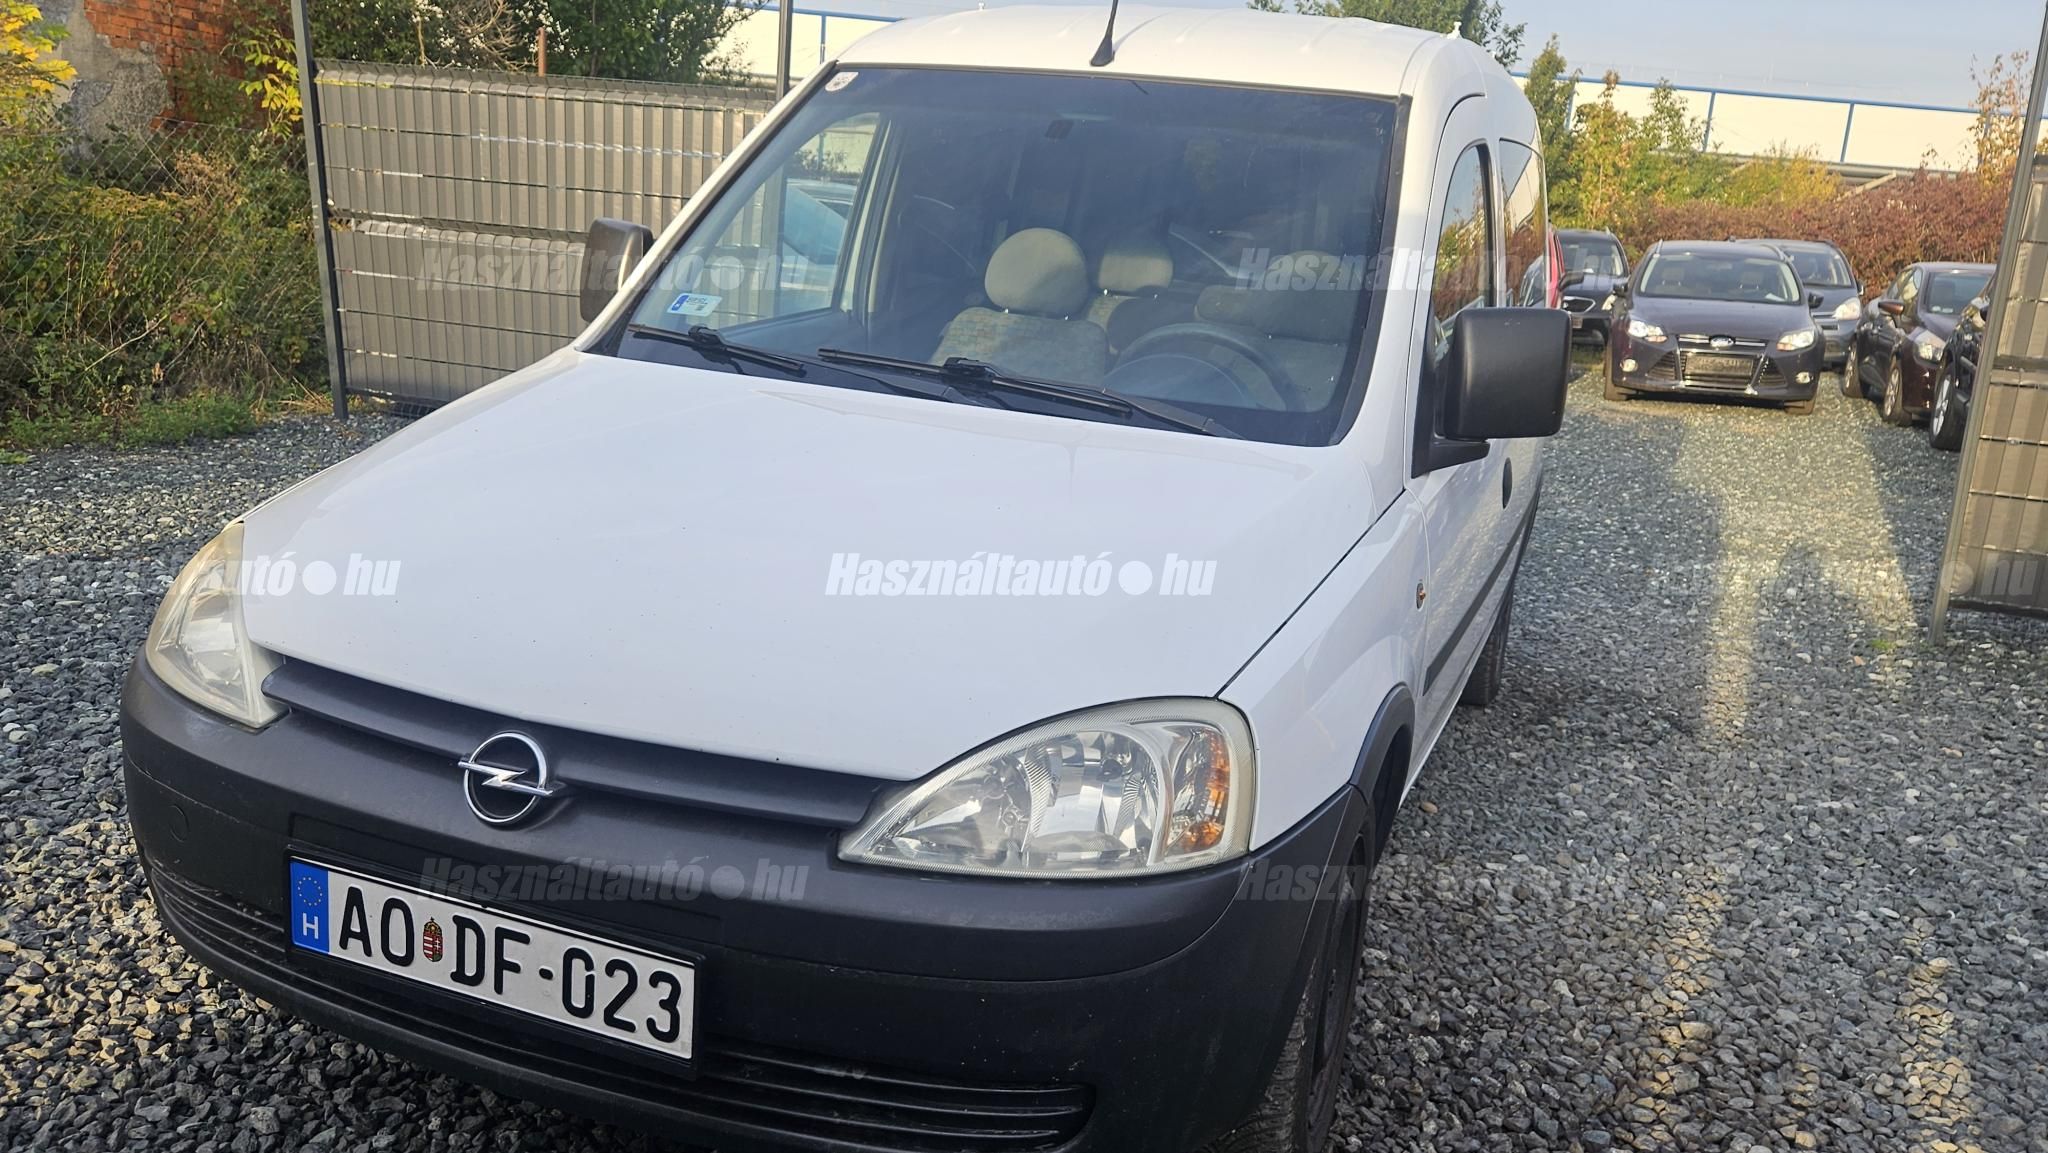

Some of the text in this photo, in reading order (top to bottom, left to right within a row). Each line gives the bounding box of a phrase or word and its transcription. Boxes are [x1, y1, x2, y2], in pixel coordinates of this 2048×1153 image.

[301, 912, 320, 940] H
[338, 884, 683, 1044] AO DF-023
